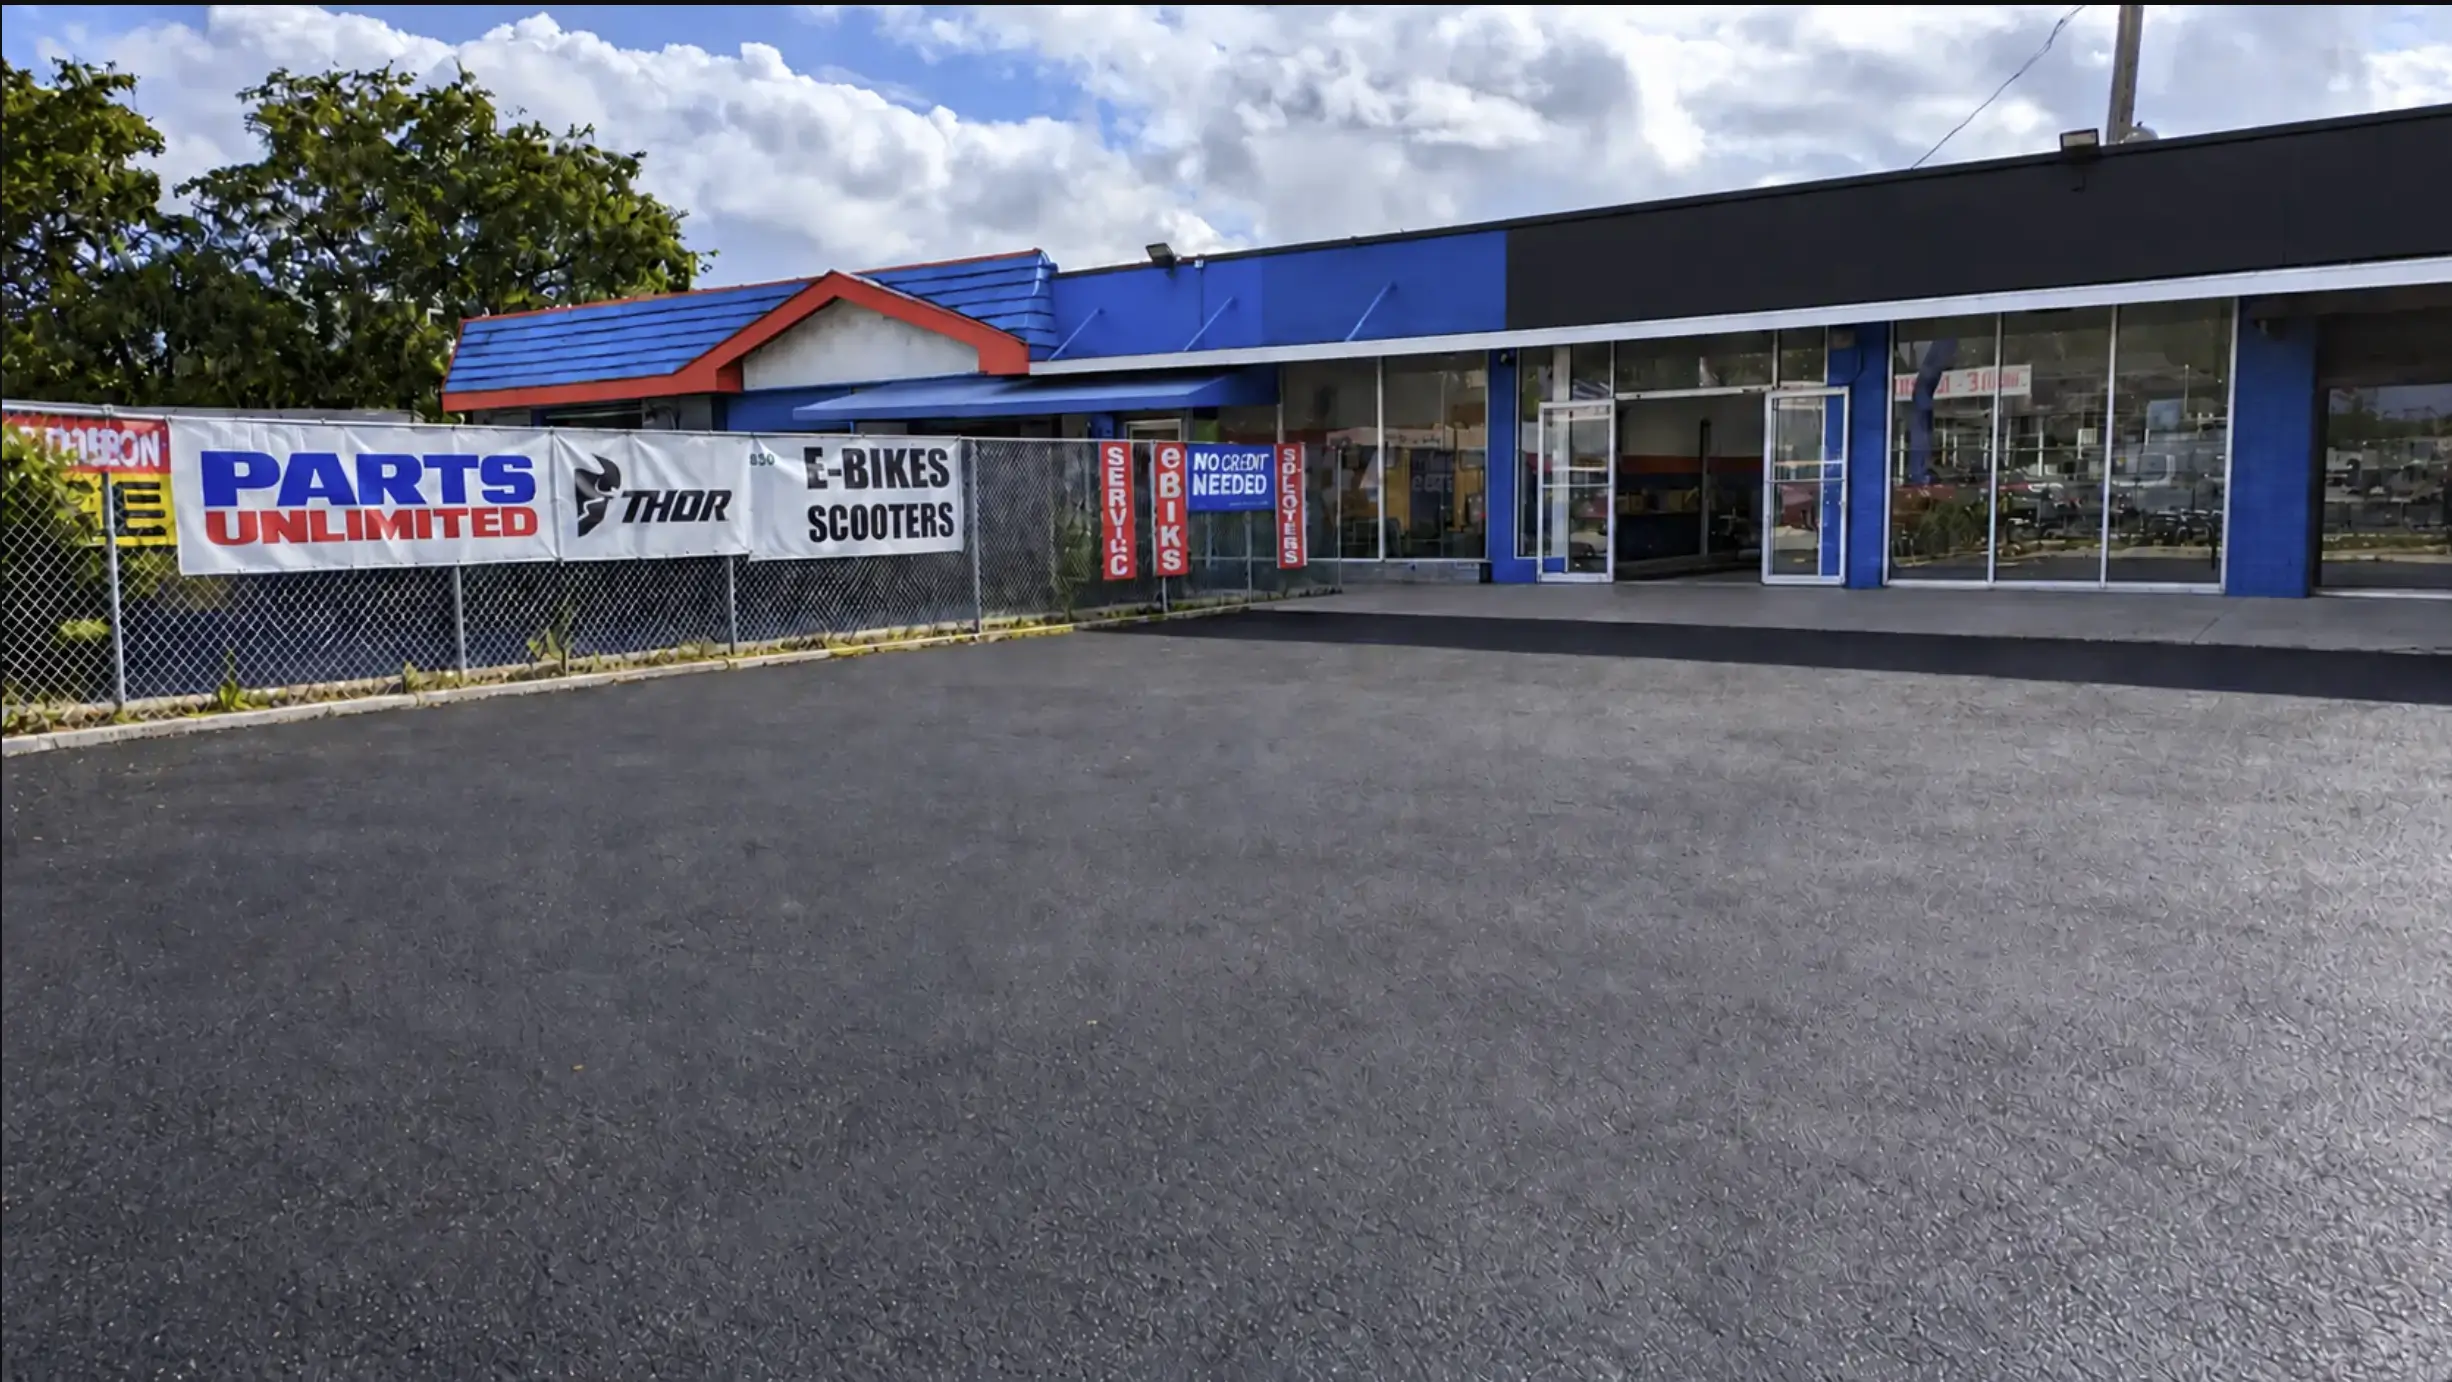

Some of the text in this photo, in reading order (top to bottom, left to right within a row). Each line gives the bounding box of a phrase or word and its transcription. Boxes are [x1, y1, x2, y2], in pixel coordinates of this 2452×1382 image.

[200, 450, 536, 507] PARTS
[803, 446, 950, 490] E-BIKES
[1193, 452, 1220, 472] NO
[1192, 473, 1268, 497] NEEDED
[205, 506, 538, 546] UNLIMITED
[621, 489, 732, 524] THOR
[807, 501, 956, 543] SCOOTERS
[1159, 447, 1181, 571] eBIKS
